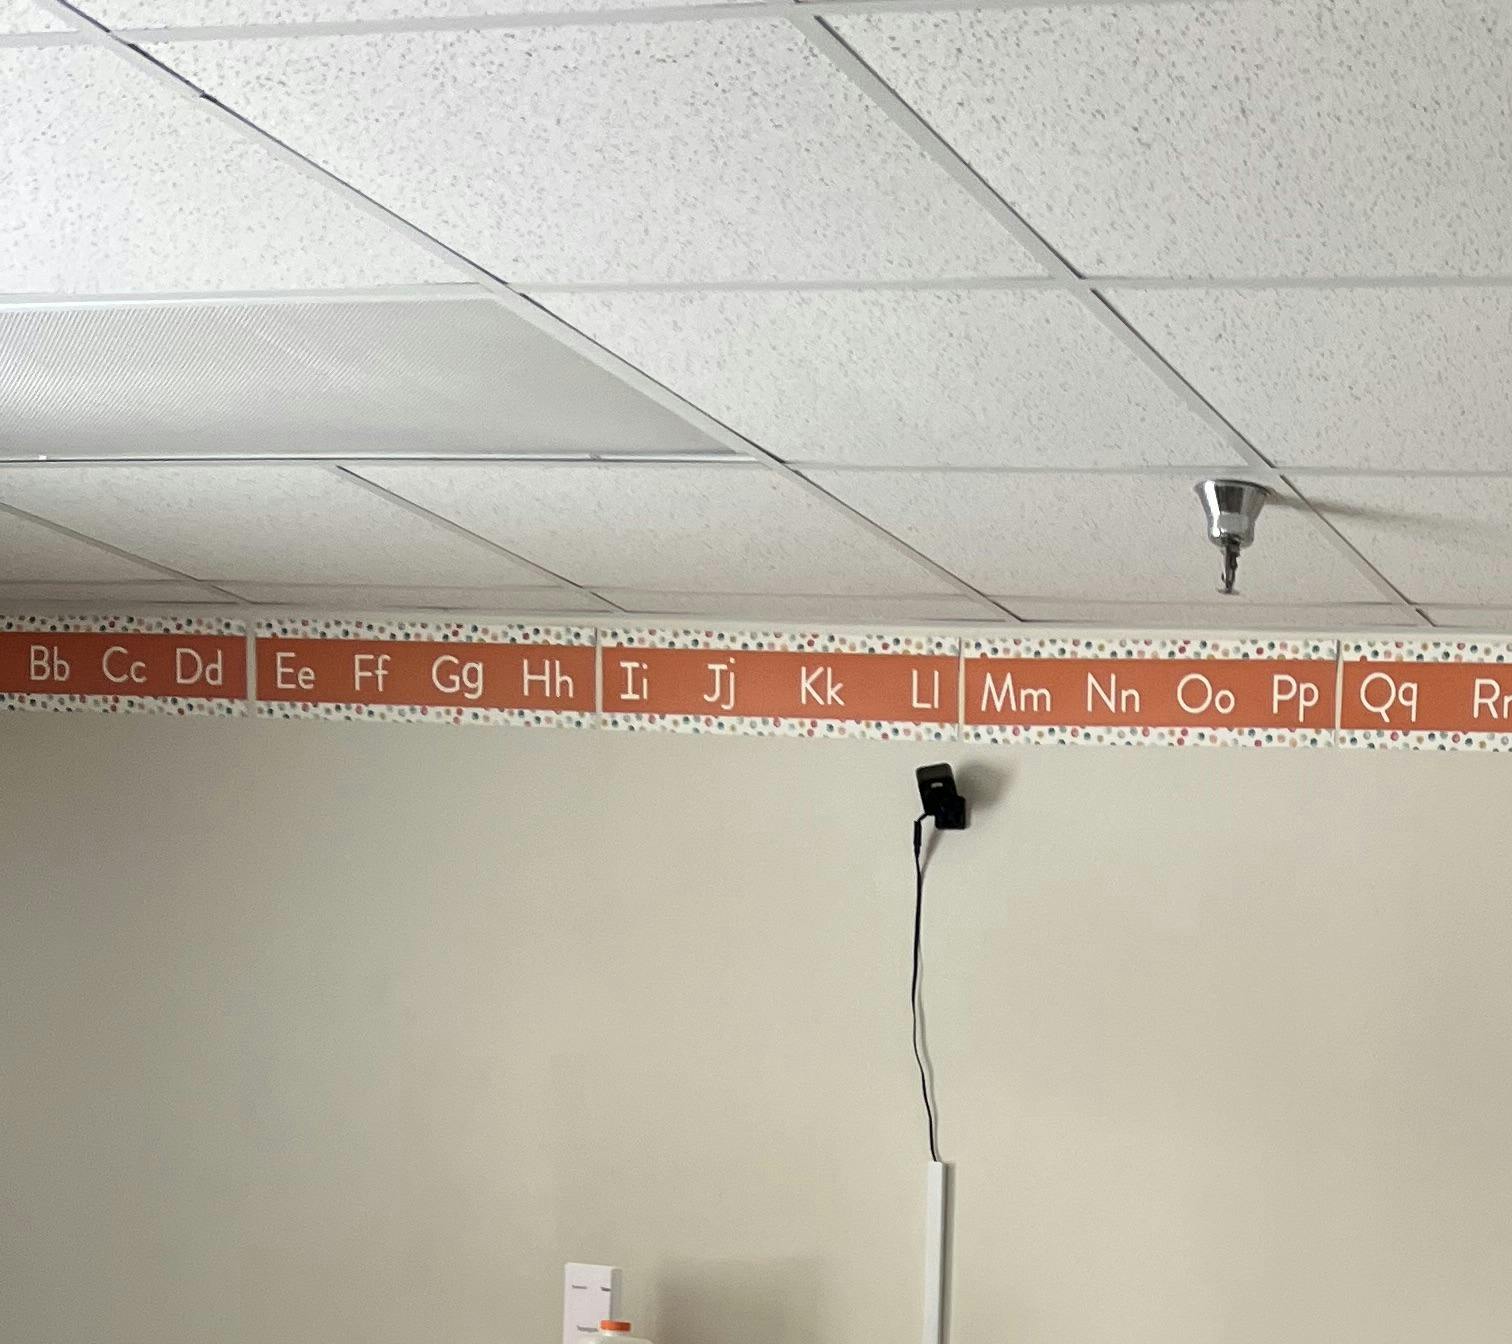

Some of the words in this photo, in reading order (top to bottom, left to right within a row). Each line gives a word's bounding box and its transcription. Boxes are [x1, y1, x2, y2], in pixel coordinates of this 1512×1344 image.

[31, 646, 69, 681] Bb
[103, 647, 146, 682] Cc
[175, 648, 222, 684] Dd
[277, 652, 314, 689] Ee
[355, 655, 390, 691] Ff
[432, 655, 482, 699] Gg
[524, 660, 573, 697] Hh
[620, 662, 647, 699] Ii
[704, 658, 734, 710] Jj
[801, 667, 844, 705] Kk
[913, 670, 938, 708] Ll
[982, 673, 1050, 712] Mm
[1088, 673, 1139, 712] Nn
[1177, 674, 1234, 713] Oo
[1273, 675, 1318, 722] Pp
[1361, 672, 1417, 722] Qq
